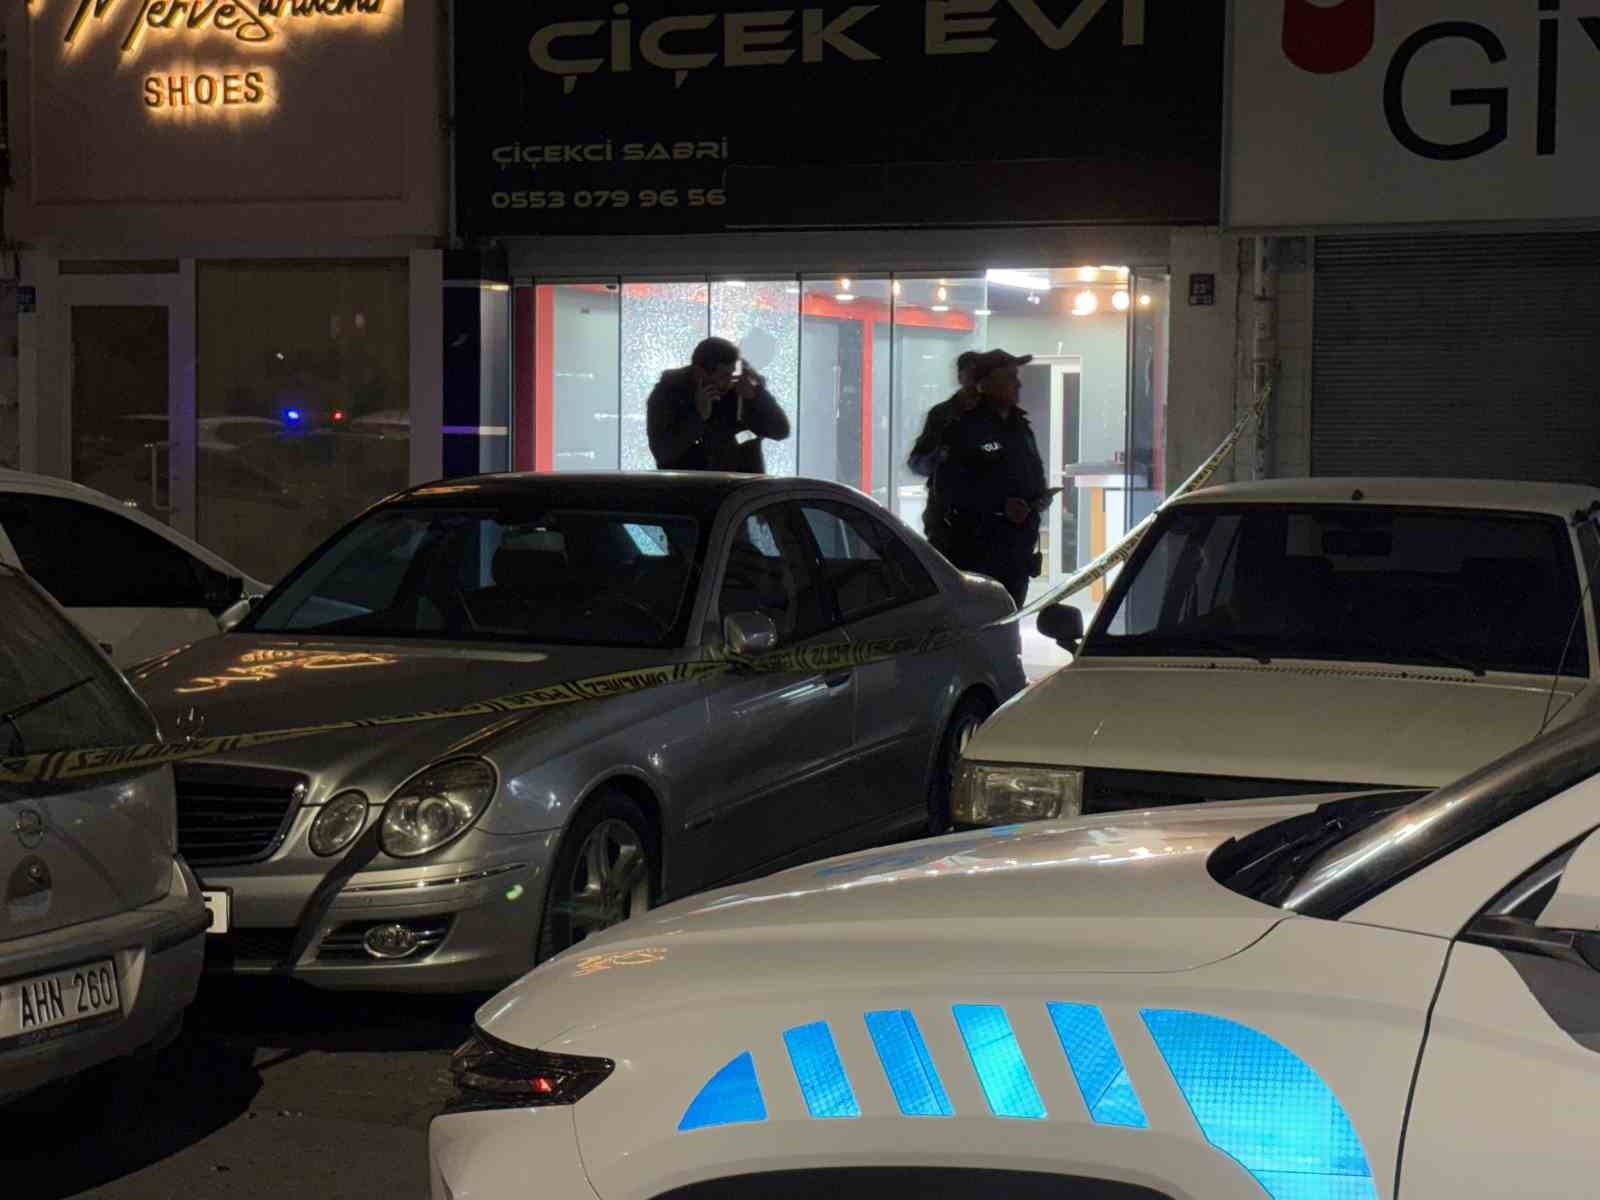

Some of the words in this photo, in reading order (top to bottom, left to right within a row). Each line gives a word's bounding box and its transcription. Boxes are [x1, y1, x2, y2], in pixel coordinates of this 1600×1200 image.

[528, 1, 885, 95] ÇİÇEK
[144, 71, 265, 108] SHOES
[1384, 0, 1600, 160] Gİ
[491, 138, 614, 170] ÇİÇEKCİ
[623, 136, 728, 160] SABRİ
[491, 191, 567, 209] 0553
[573, 189, 630, 208] 079
[638, 187, 680, 207] 96
[688, 186, 728, 207] 56
[22, 976, 64, 1028] AHN
[74, 967, 112, 1011] 260
